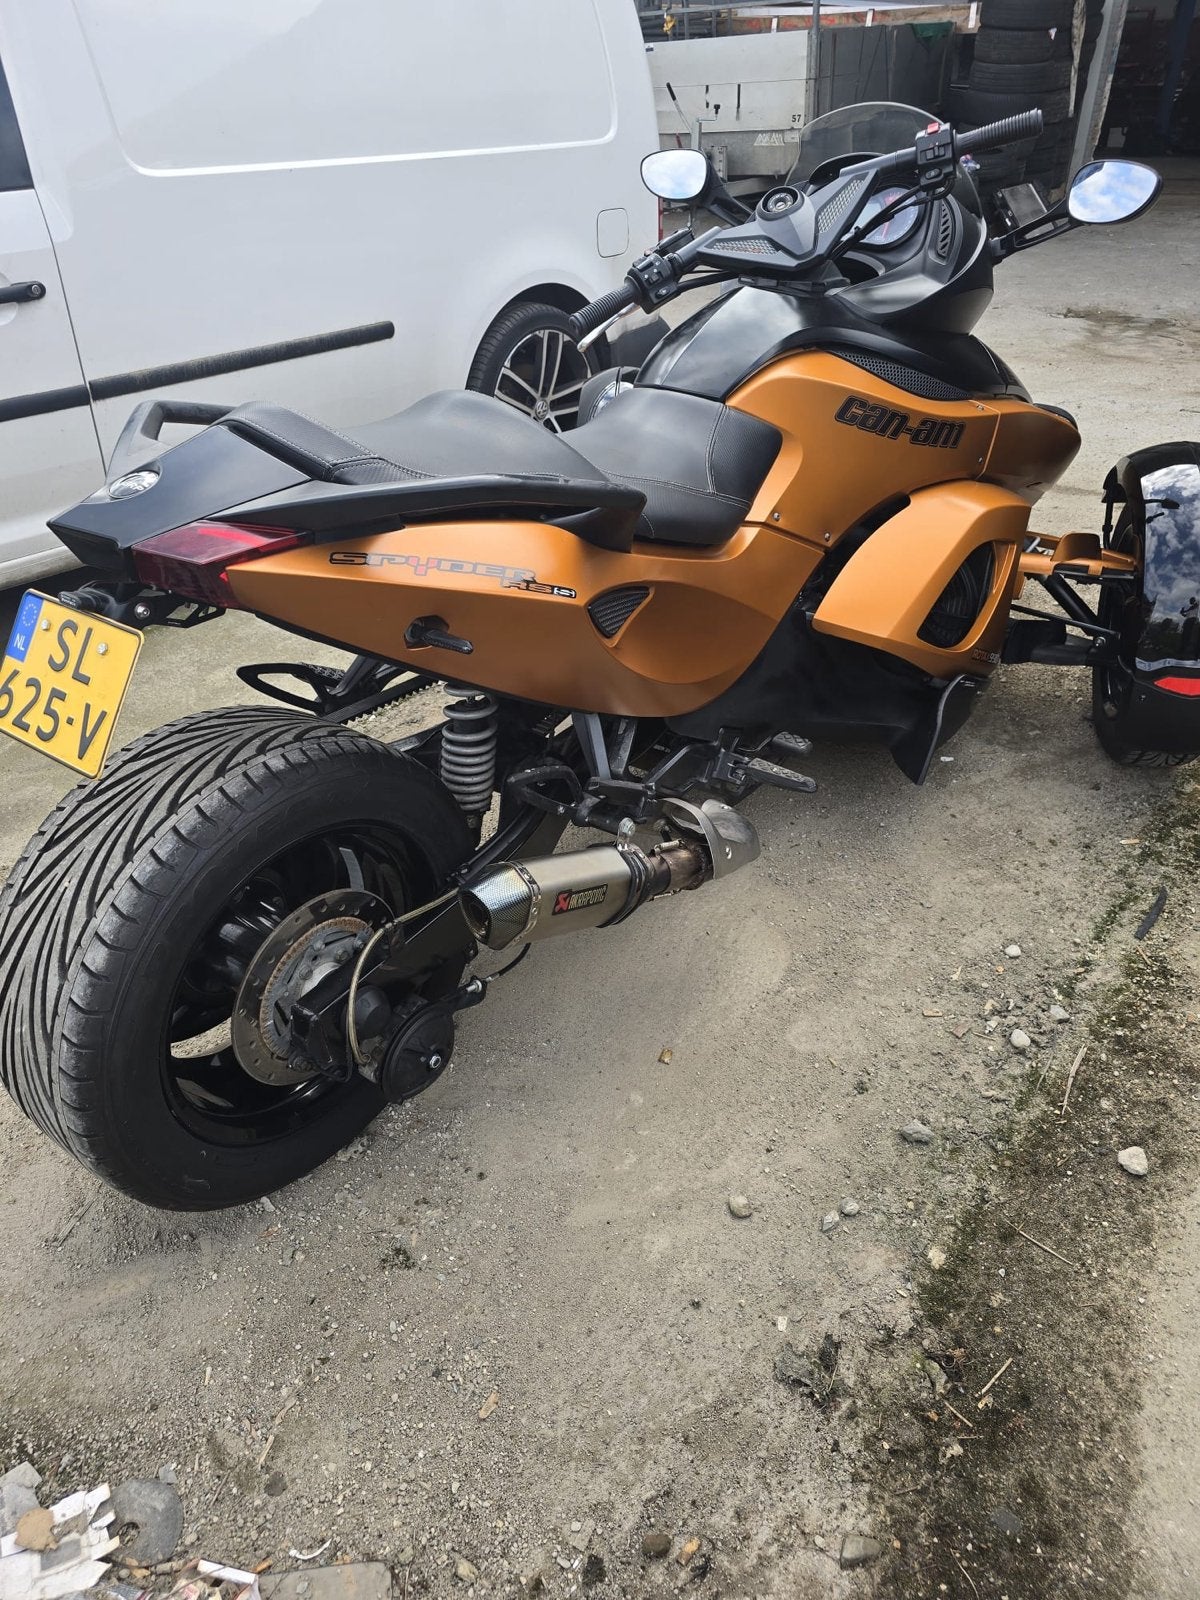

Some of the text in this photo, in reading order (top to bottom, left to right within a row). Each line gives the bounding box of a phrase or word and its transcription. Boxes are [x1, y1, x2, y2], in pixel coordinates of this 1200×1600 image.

[791, 114, 802, 123] 57
[329, 551, 537, 583] SPYDER
[13, 632, 26, 652] NL
[48, 619, 94, 686] SL
